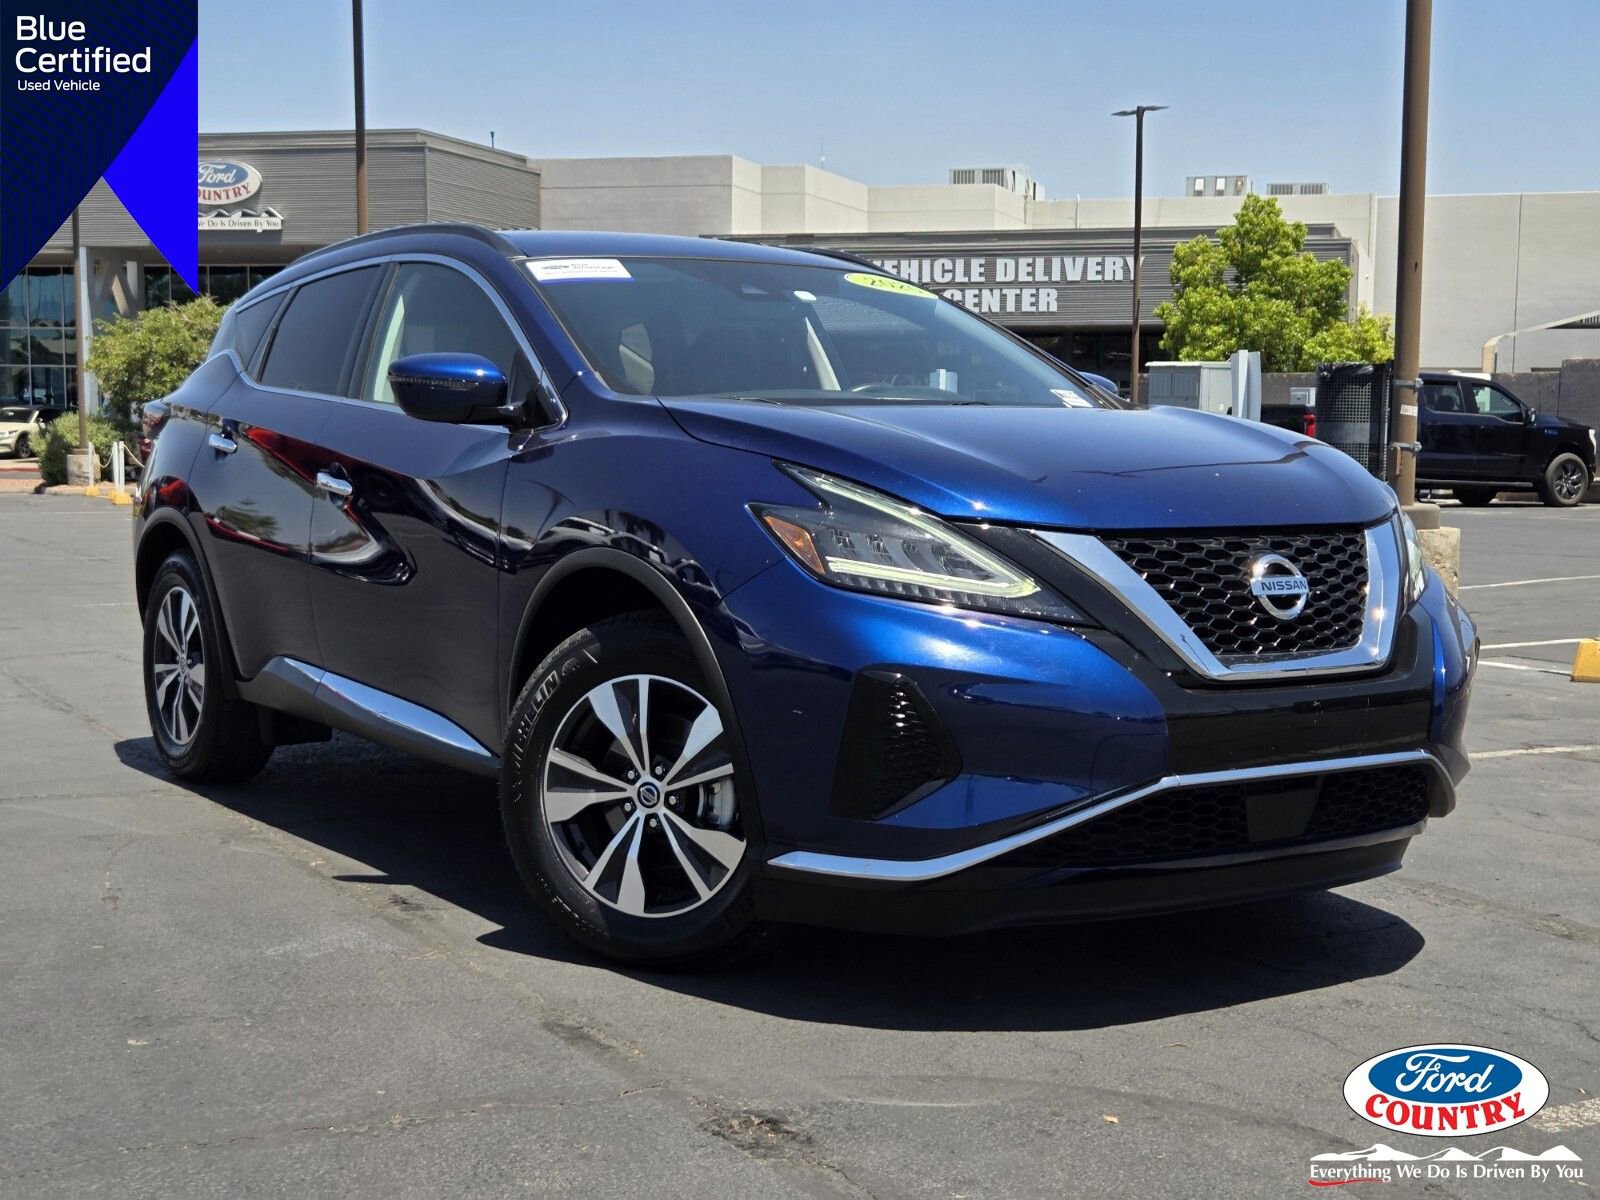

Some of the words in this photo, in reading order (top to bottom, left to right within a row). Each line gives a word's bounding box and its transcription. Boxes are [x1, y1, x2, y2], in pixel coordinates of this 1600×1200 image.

[198, 164, 237, 183] Ford
[198, 183, 251, 200] UNTRY
[228, 219, 252, 228] Driven
[254, 219, 263, 229] By
[266, 219, 279, 228] You
[872, 257, 985, 283] EHICLE
[995, 256, 1146, 282] DELIVERY
[1260, 580, 1307, 591] NISSAN
